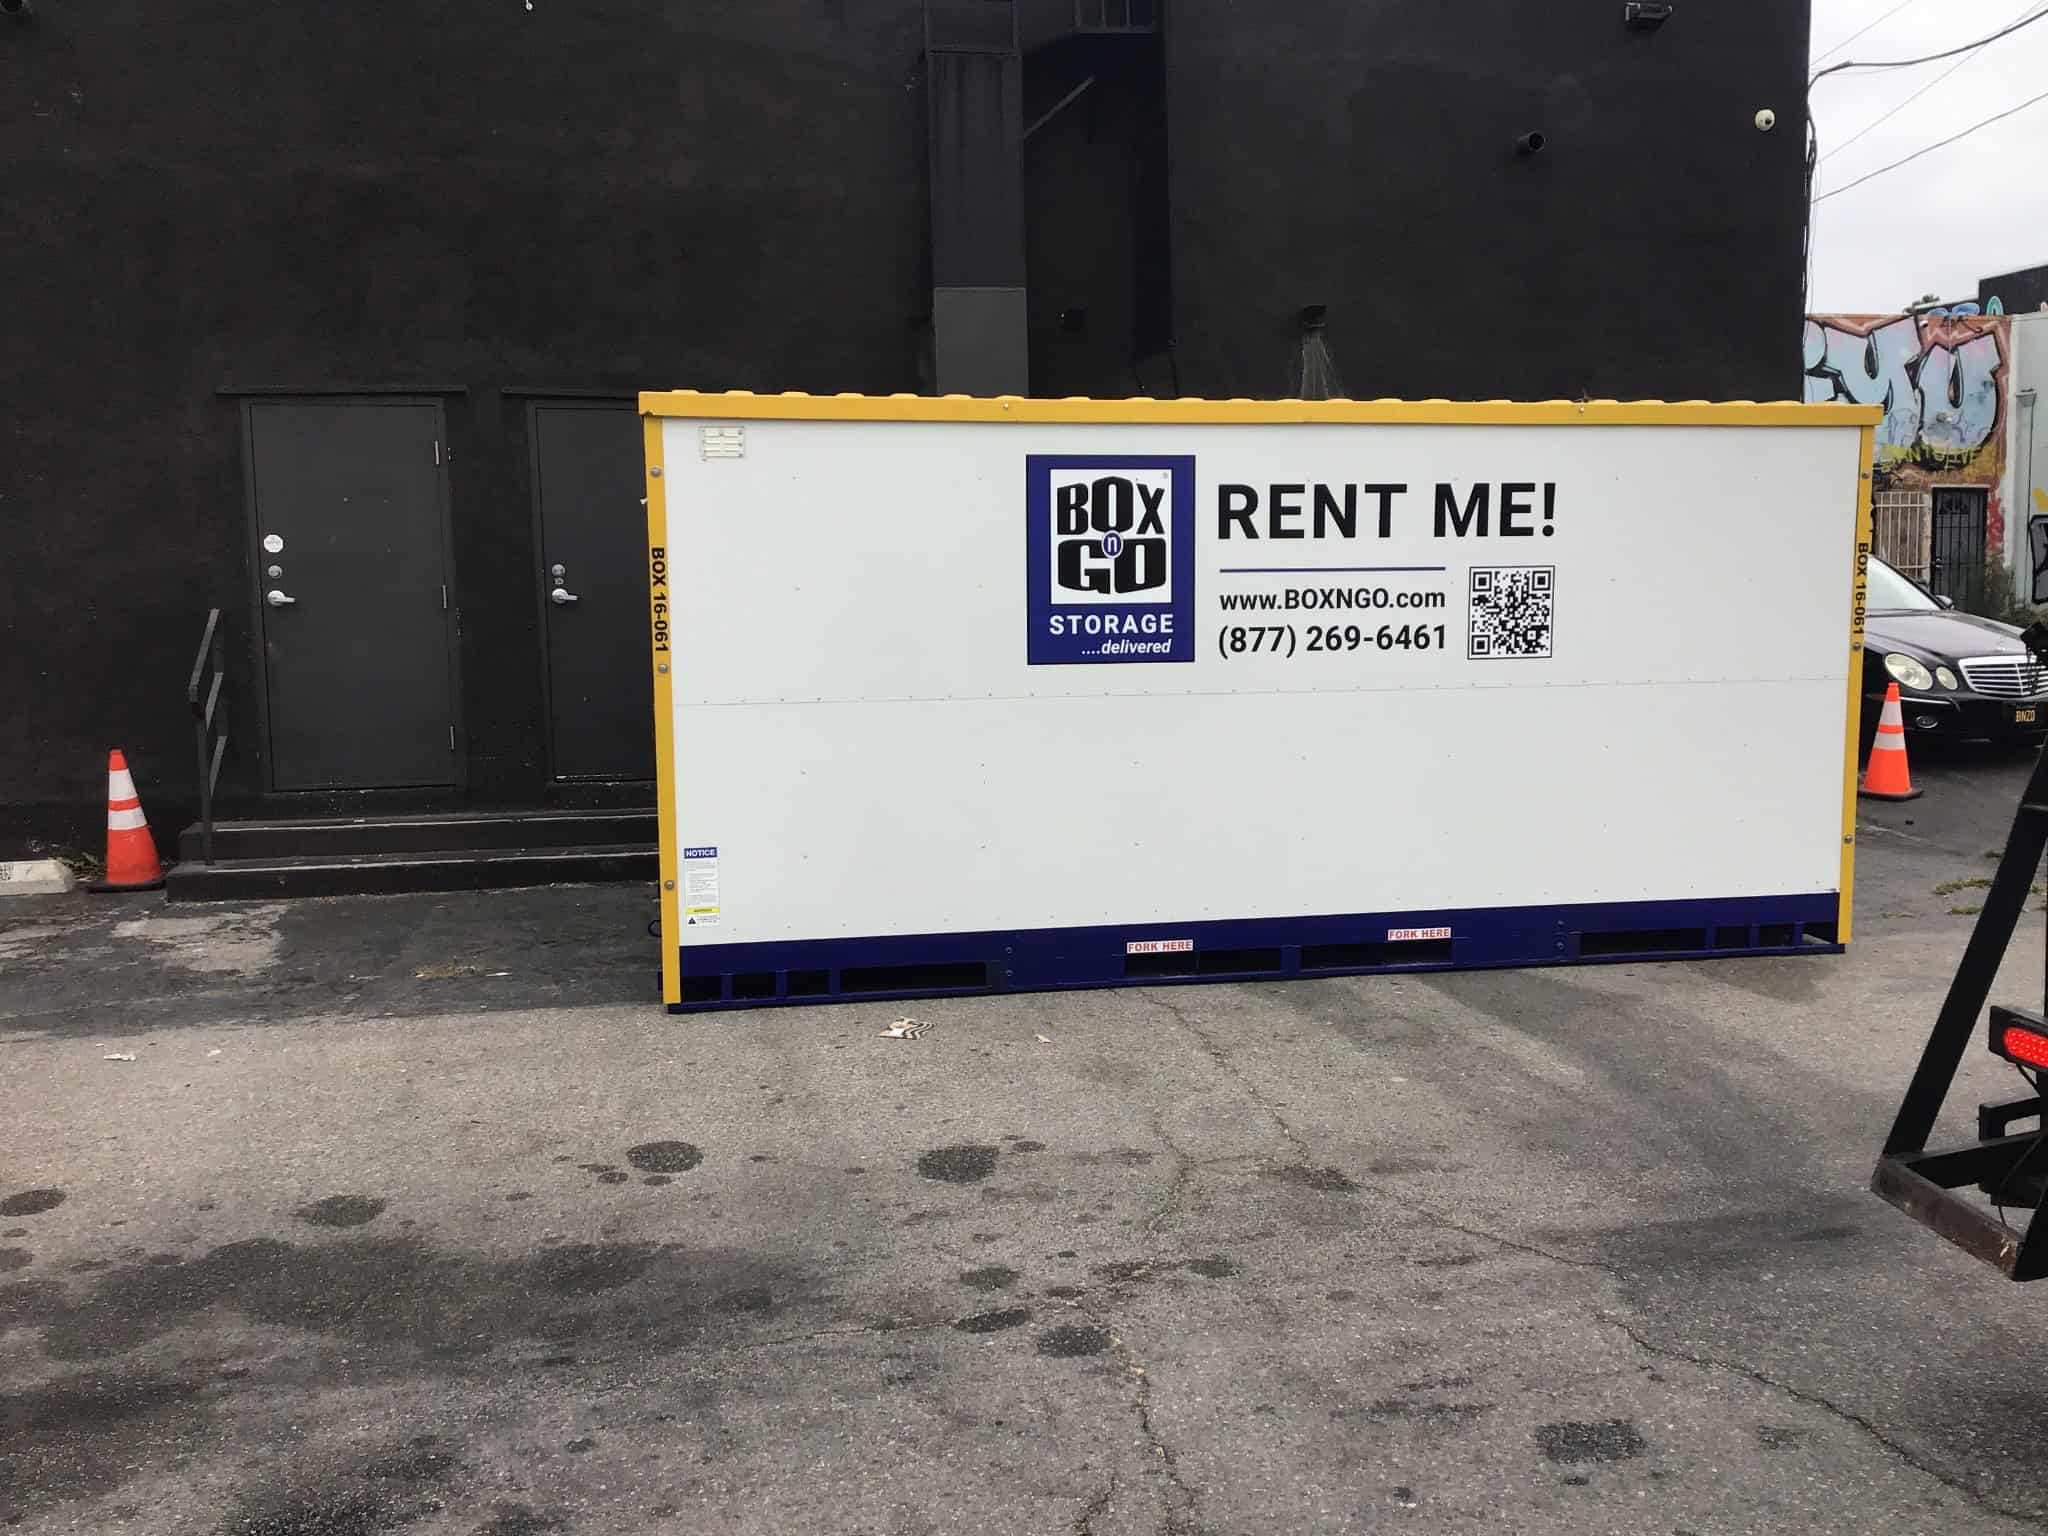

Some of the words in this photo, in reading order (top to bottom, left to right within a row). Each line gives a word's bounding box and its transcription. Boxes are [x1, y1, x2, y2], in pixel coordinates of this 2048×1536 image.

[1057, 476, 1165, 535] BOX
[1217, 483, 1407, 539] RENT
[1433, 482, 1556, 537] ME!
[652, 548, 666, 586] BOX
[1058, 538, 1166, 594] GO
[1857, 543, 1868, 576] BOX
[1219, 587, 1446, 610] www.BOXNGO.com
[1853, 583, 1866, 634] 16-061
[654, 592, 668, 651] 16-061
[1049, 613, 1174, 635] STORAGE
[1218, 624, 1296, 660] (877)
[1306, 624, 1446, 651] 269-6461
[686, 849, 716, 857] NOTICE
[1128, 942, 1158, 952] FORK
[1163, 941, 1192, 950] HERE
[1389, 930, 1416, 939] FORK
[1422, 928, 1449, 938] HERE
